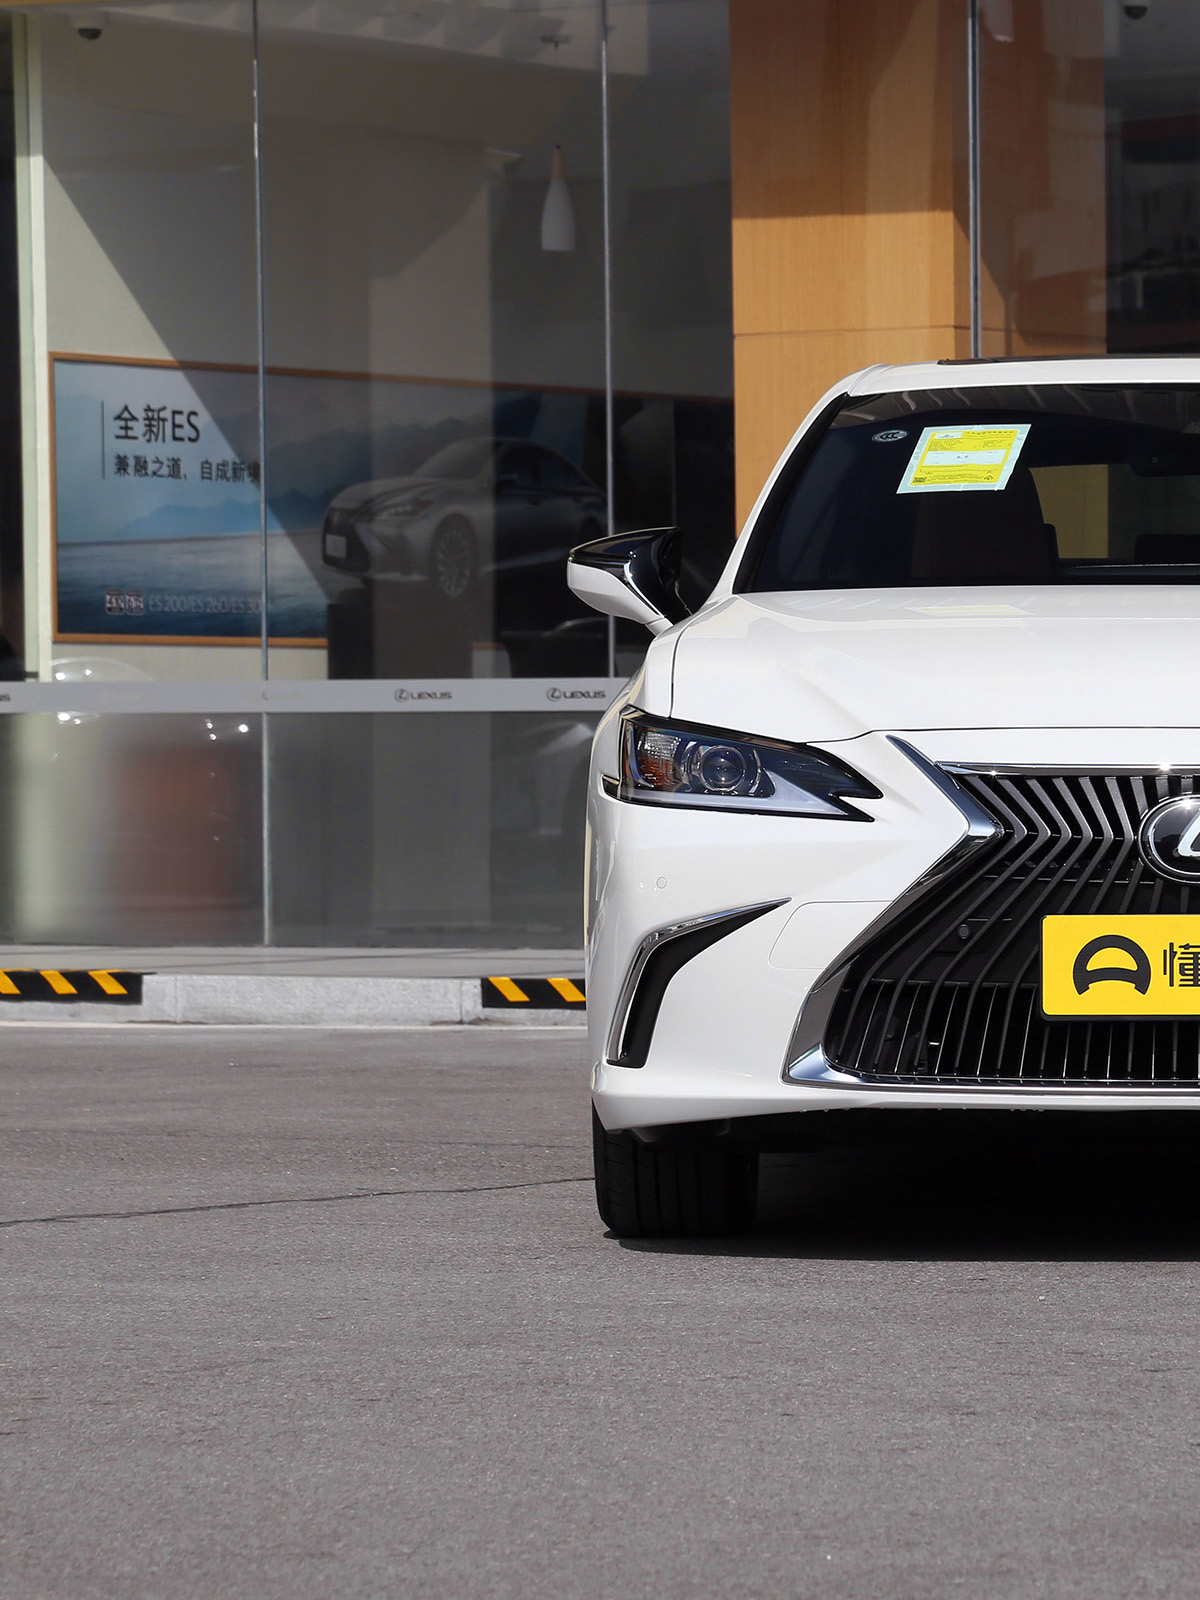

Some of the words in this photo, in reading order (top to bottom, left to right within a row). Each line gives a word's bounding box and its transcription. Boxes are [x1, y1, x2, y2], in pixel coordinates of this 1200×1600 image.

[113, 404, 200, 443] 全新ES
[410, 691, 452, 700] LEXUS
[563, 690, 606, 699] LEXUS
